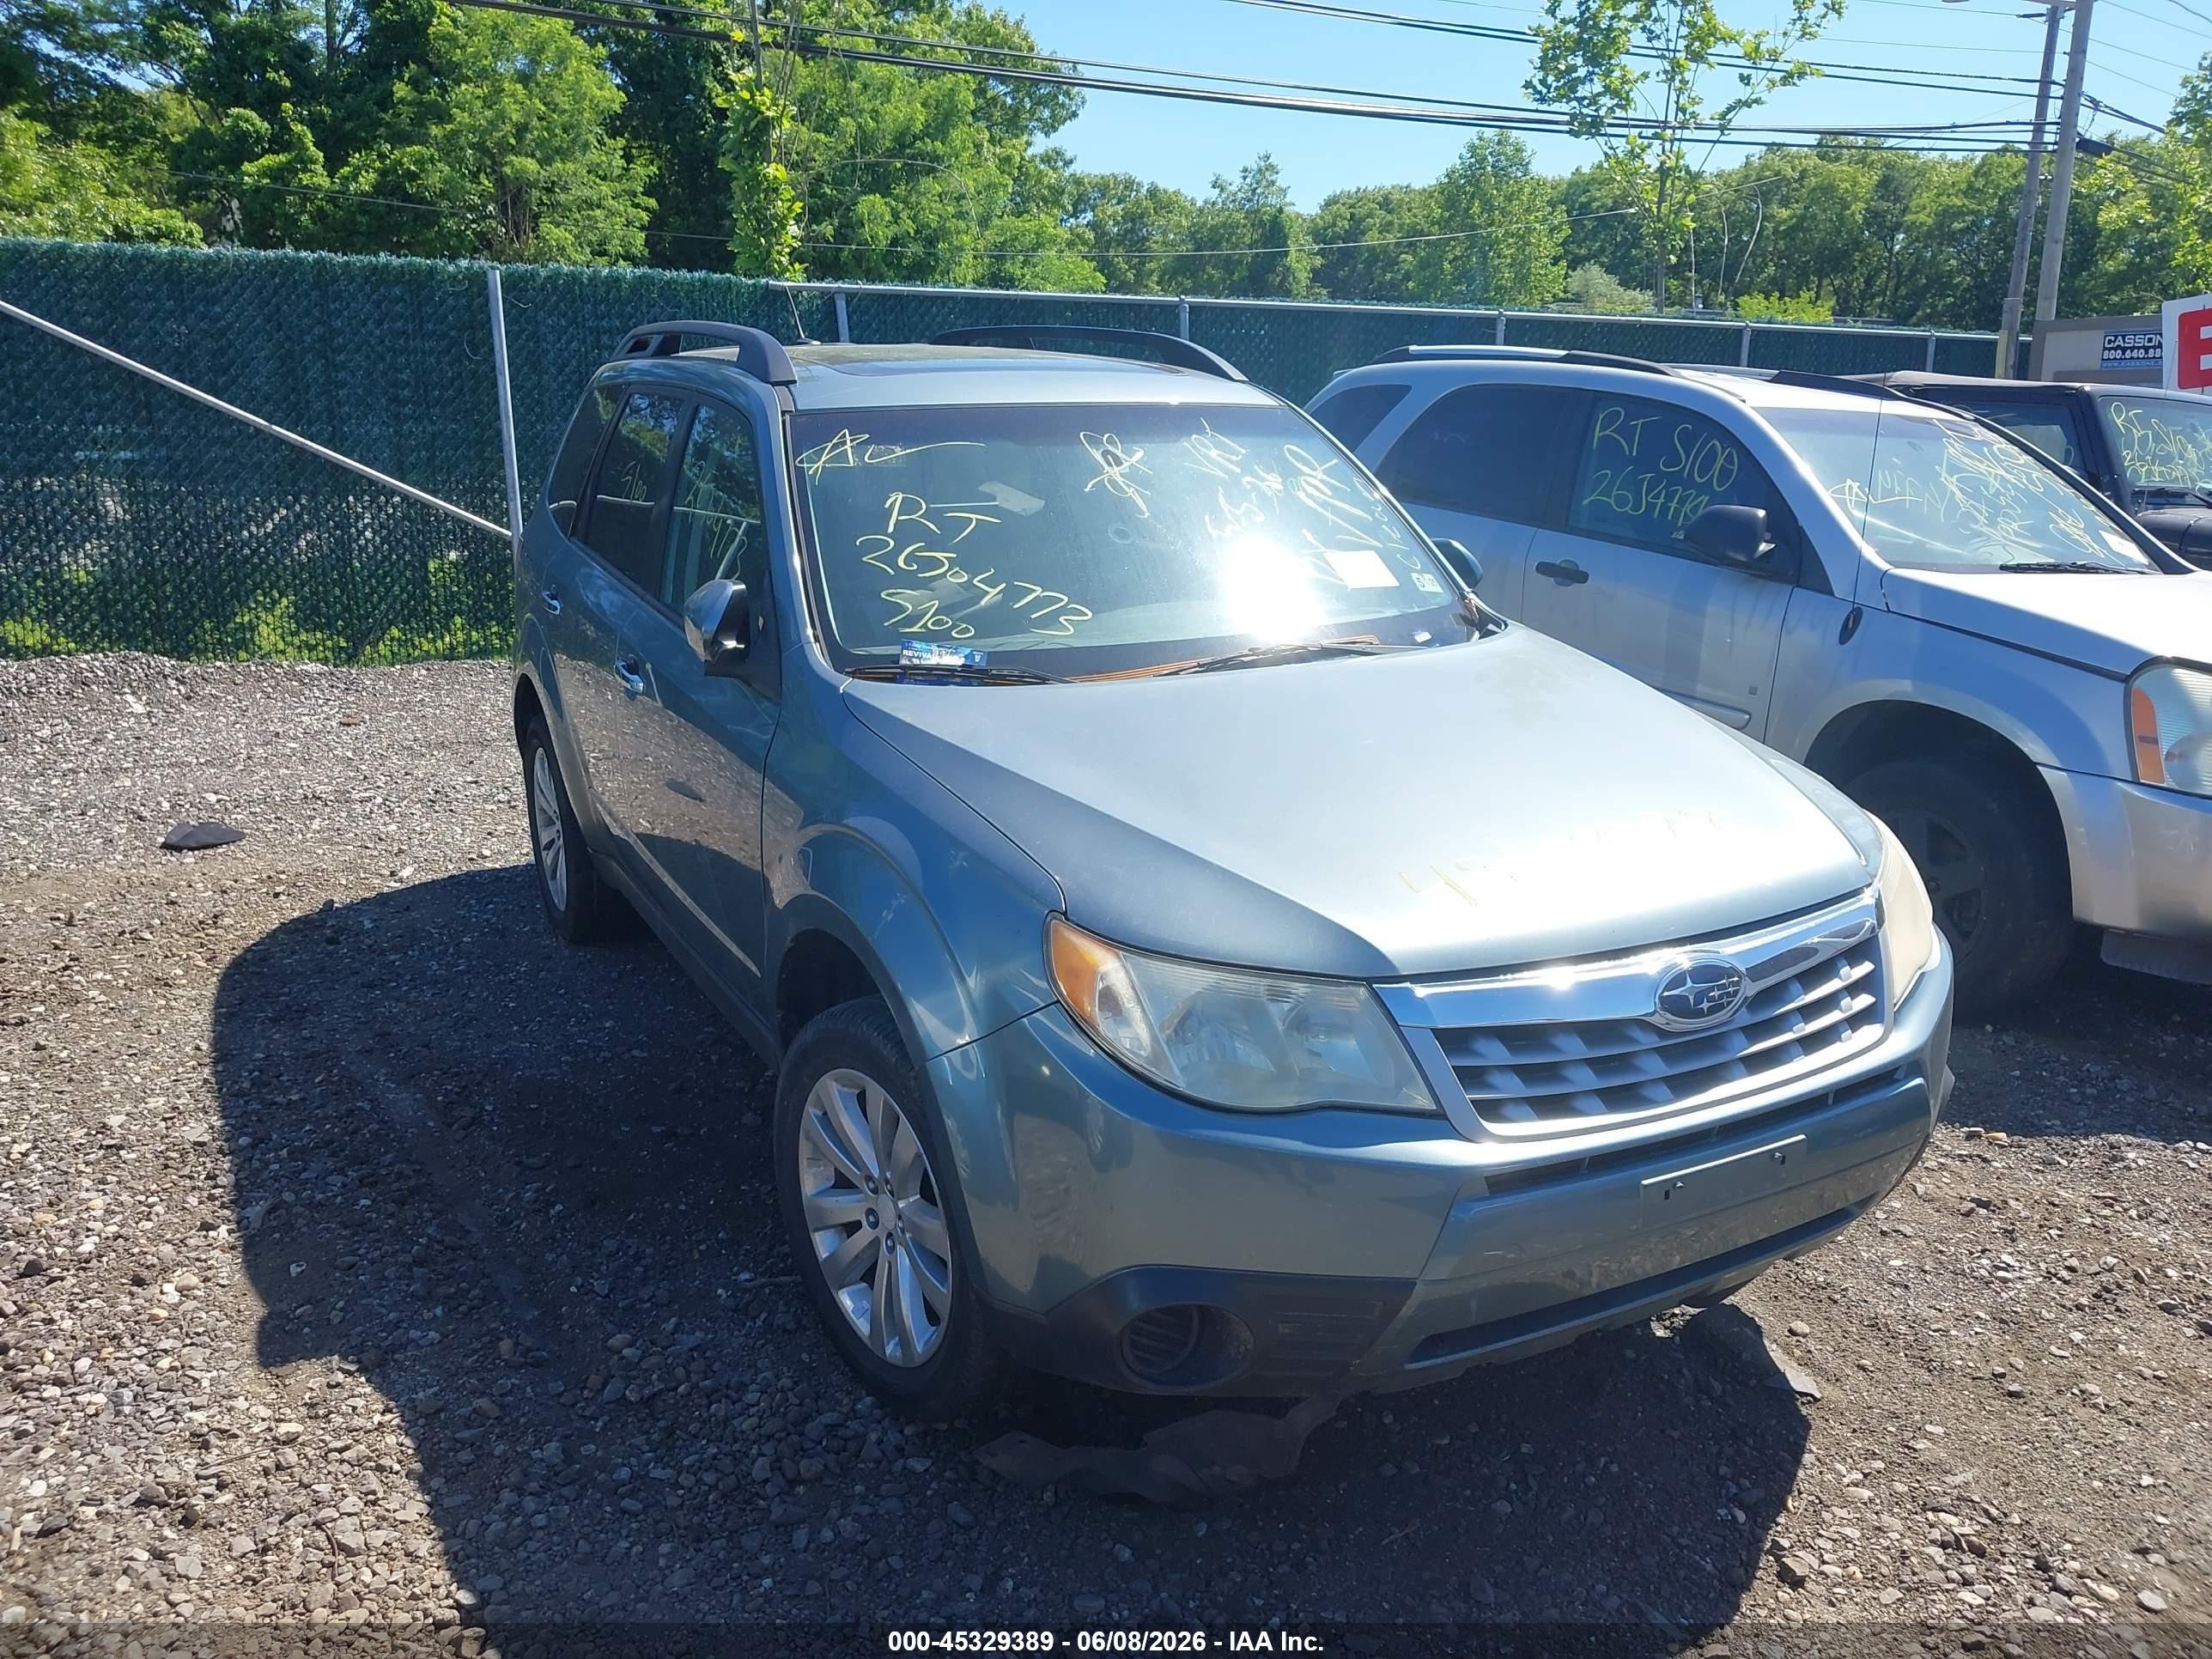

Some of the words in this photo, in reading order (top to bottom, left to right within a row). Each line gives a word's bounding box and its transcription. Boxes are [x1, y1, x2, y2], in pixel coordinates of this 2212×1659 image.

[2102, 348, 2163, 360] 800.640.88
[1593, 406, 1662, 457] RT
[884, 491, 1002, 544] RT
